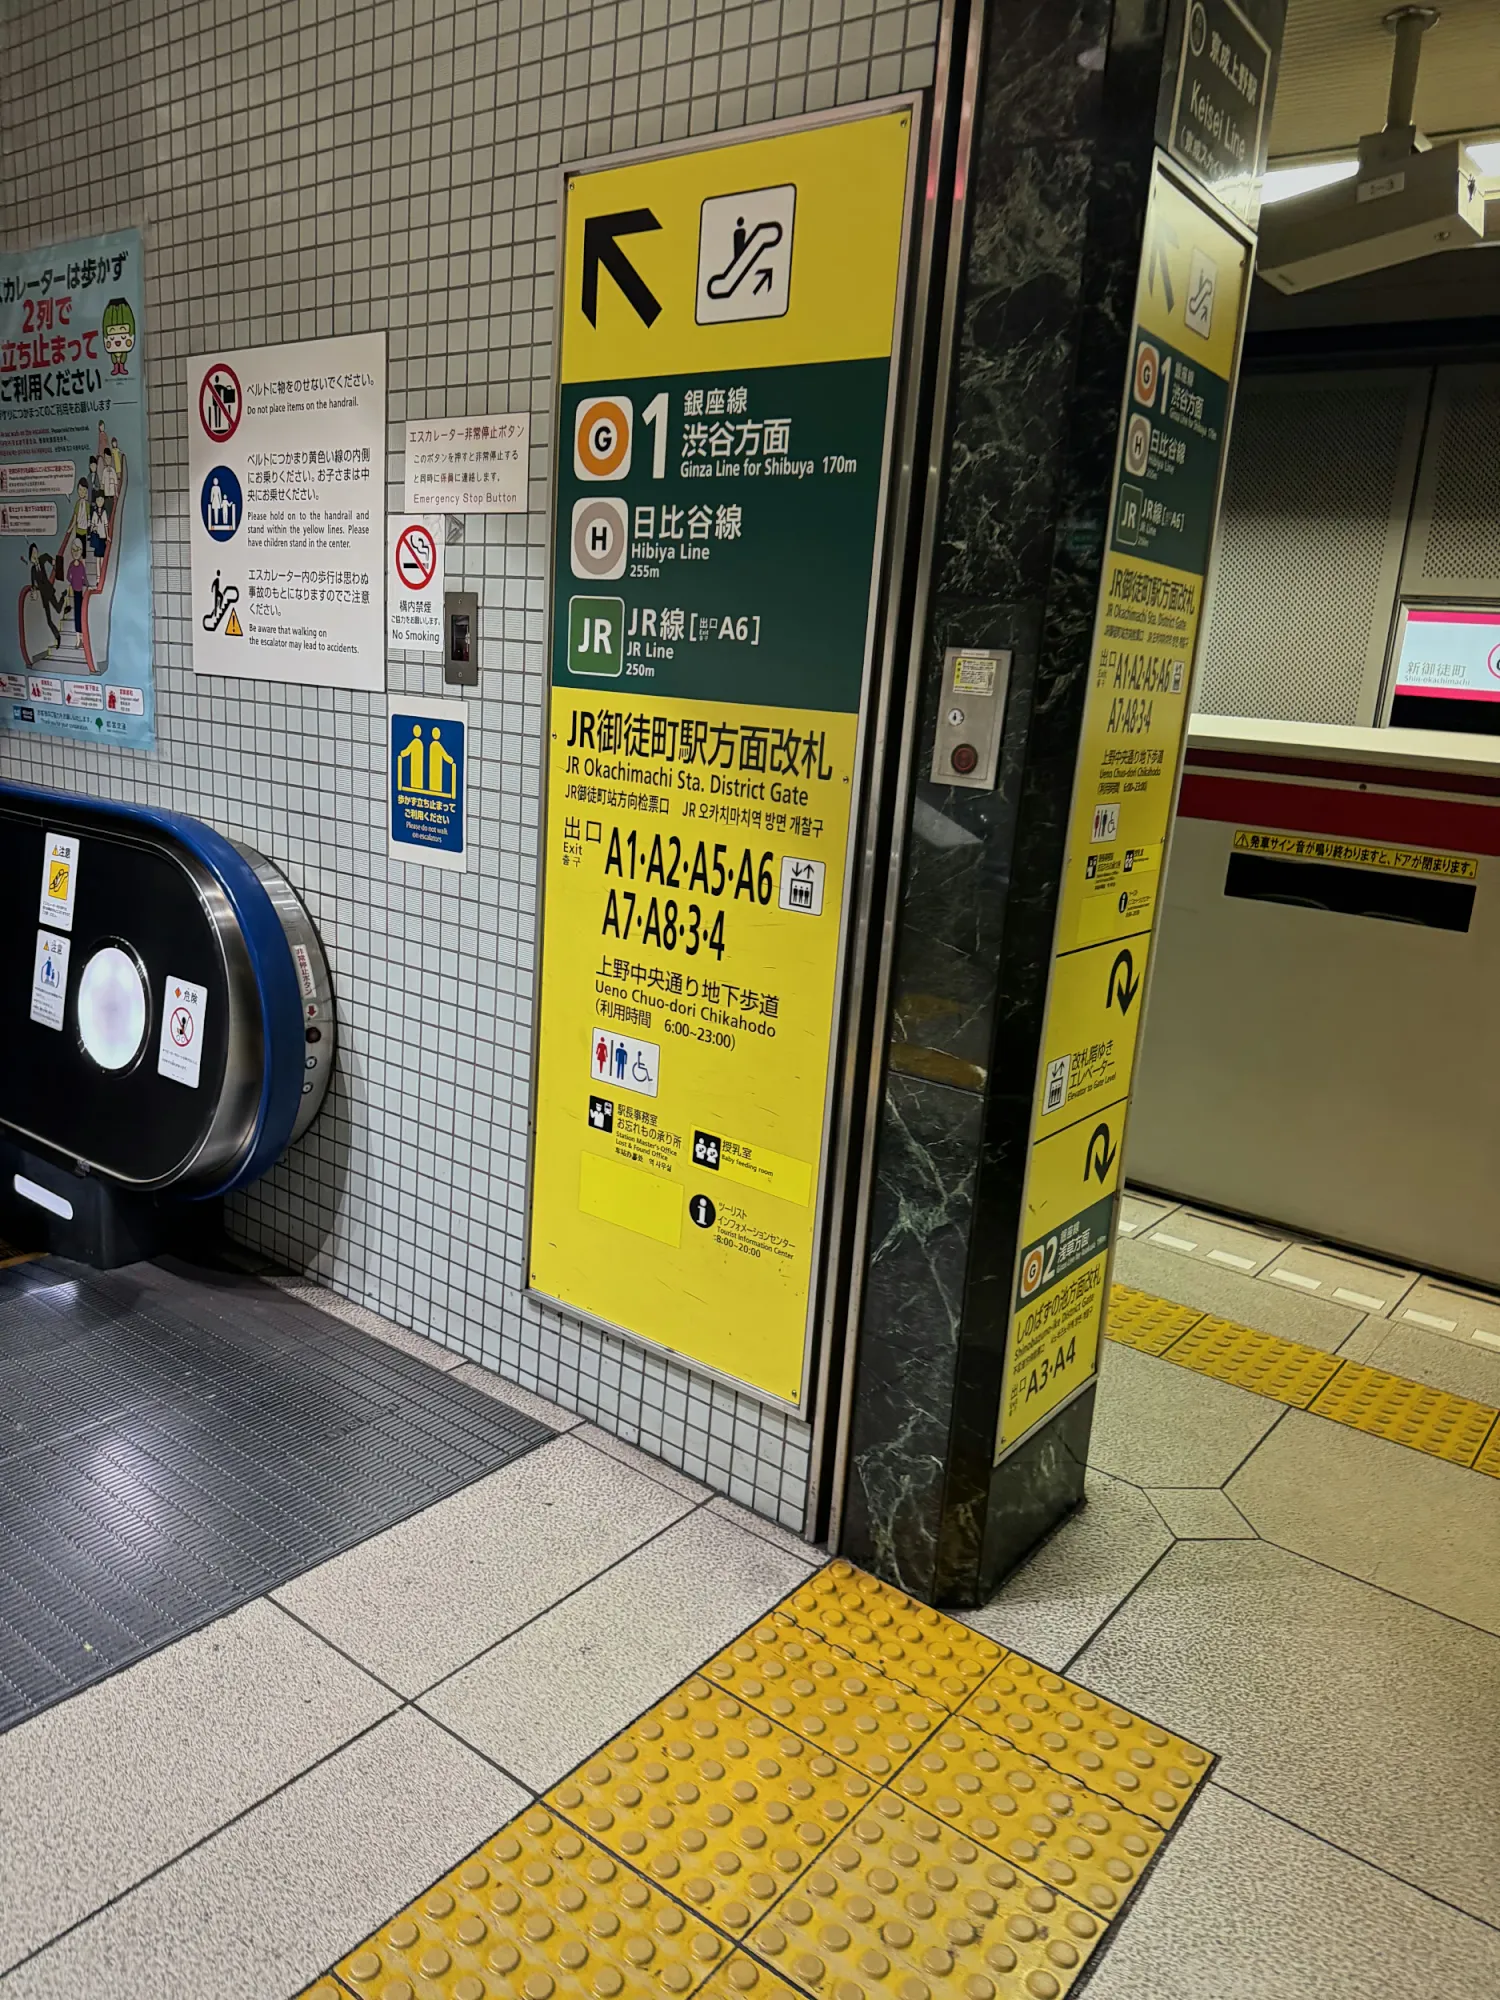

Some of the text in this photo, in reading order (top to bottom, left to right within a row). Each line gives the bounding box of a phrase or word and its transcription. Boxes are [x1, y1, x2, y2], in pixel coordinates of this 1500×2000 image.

[1190, 79, 1245, 162] Keisei Line
[0, 251, 129, 304] カレーターは歩かず
[23, 297, 72, 333] 2列で
[0, 330, 98, 372] 立ち止まって
[1, 368, 102, 403] ご利用ください
[247, 374, 374, 396] ベルトに物をのせないでください。
[1161, 356, 1172, 415] 1
[247, 406, 256, 415] Do
[257, 406, 268, 414] not
[269, 404, 285, 415] place
[287, 403, 304, 412] items
[316, 400, 327, 409] the
[329, 397, 358, 408] handrail.
[684, 386, 748, 416] 銀座線
[409, 425, 524, 443] エスカレーター非常停止ボタン
[594, 426, 612, 452] G
[642, 392, 669, 479] 1
[681, 418, 792, 458] 渋谷方面
[247, 448, 370, 465] ベルトにつかまり黄色い線の内側
[413, 450, 518, 464] このボタンを押すと非常停止する
[1150, 428, 1186, 465] 日比谷線
[248, 468, 370, 484] にお乗りください。お子さまは中
[413, 472, 501, 484] と同時に係員に連絡します。
[680, 455, 857, 479] Ginza Line for Shibuya 170m
[247, 488, 319, 502] 央にお乗せください。
[413, 493, 516, 506] Emergency Stop Button
[248, 512, 266, 520] Please
[270, 511, 284, 520] hold
[310, 511, 321, 520] the
[324, 511, 352, 520] handrail
[356, 511, 369, 520] and
[634, 503, 742, 541] 日比谷線
[1122, 500, 1136, 529] JR
[248, 525, 369, 535] stand within the yellow lines. Please
[591, 526, 607, 551] H
[248, 538, 262, 547] have
[264, 539, 288, 547] children
[316, 540, 327, 548] the
[631, 542, 710, 563] Hibiya Line
[248, 569, 369, 585] エスカレーター内の歩行は思わぬ
[630, 564, 660, 578] 255m
[248, 586, 370, 604] 事故のもとになりますのでご注意
[250, 604, 282, 616] ください。
[400, 600, 432, 614] 構内禁煙
[278, 626, 291, 635] that
[292, 627, 316, 638] walking
[391, 615, 441, 626] ご協力をお願いします。
[261, 638, 287, 648] escalator
[289, 641, 302, 651] may
[303, 641, 316, 649] lead
[327, 643, 359, 654] accidents.
[392, 629, 440, 644] No Smoking
[578, 618, 612, 654] JR
[626, 641, 674, 659] JR Line
[1100, 649, 1117, 668] 出口
[626, 663, 655, 677] 250m
[1408, 661, 1466, 678] 新御徒町
[567, 709, 833, 781] JR御徒町駅方面改札
[566, 756, 809, 806] JR Okachimachi Sta. District Gate
[398, 794, 456, 813] 歩かず立ち止まって
[565, 784, 669, 816] JR御徒町站方向检票口
[404, 809, 450, 824] ご利用ください
[406, 821, 420, 831] Please
[438, 826, 448, 835] walk
[682, 801, 824, 838] JR 오카치마치역 방면 개찰구
[564, 815, 602, 844] 出口
[563, 842, 583, 856] Exit
[1250, 835, 1474, 877] 発車サイン音が鳴り終わりますと、ドアが閉まります。
[596, 954, 780, 1019] 上野中央通り地下歩道
[596, 980, 776, 1038] Ueno Chuo-dori Chikahodo
[596, 999, 652, 1029] (利用時間
[1072, 1040, 1114, 1071] 改札階ゆき
[1069, 1060, 1115, 1089] エレベーター
[1068, 1086, 1087, 1102] Elevator
[1105, 1072, 1116, 1084] Level
[617, 1104, 658, 1127] 駅長事務室
[616, 1131, 677, 1157] Station Master's Office
[617, 1119, 682, 1149] お忘れもの承り所
[616, 1139, 627, 1148] Lost
[633, 1145, 650, 1156] Found
[651, 1150, 668, 1161] Office
[722, 1140, 752, 1160] 授乳室
[722, 1153, 773, 1177] Baby feeding room
[718, 1202, 747, 1219] ツーリスト
[717, 1225, 794, 1260] Tourist Information Center
[718, 1215, 796, 1249] インフォメーションセンター
[1042, 1235, 1058, 1285] 2
[1011, 1376, 1027, 1397] 出口
